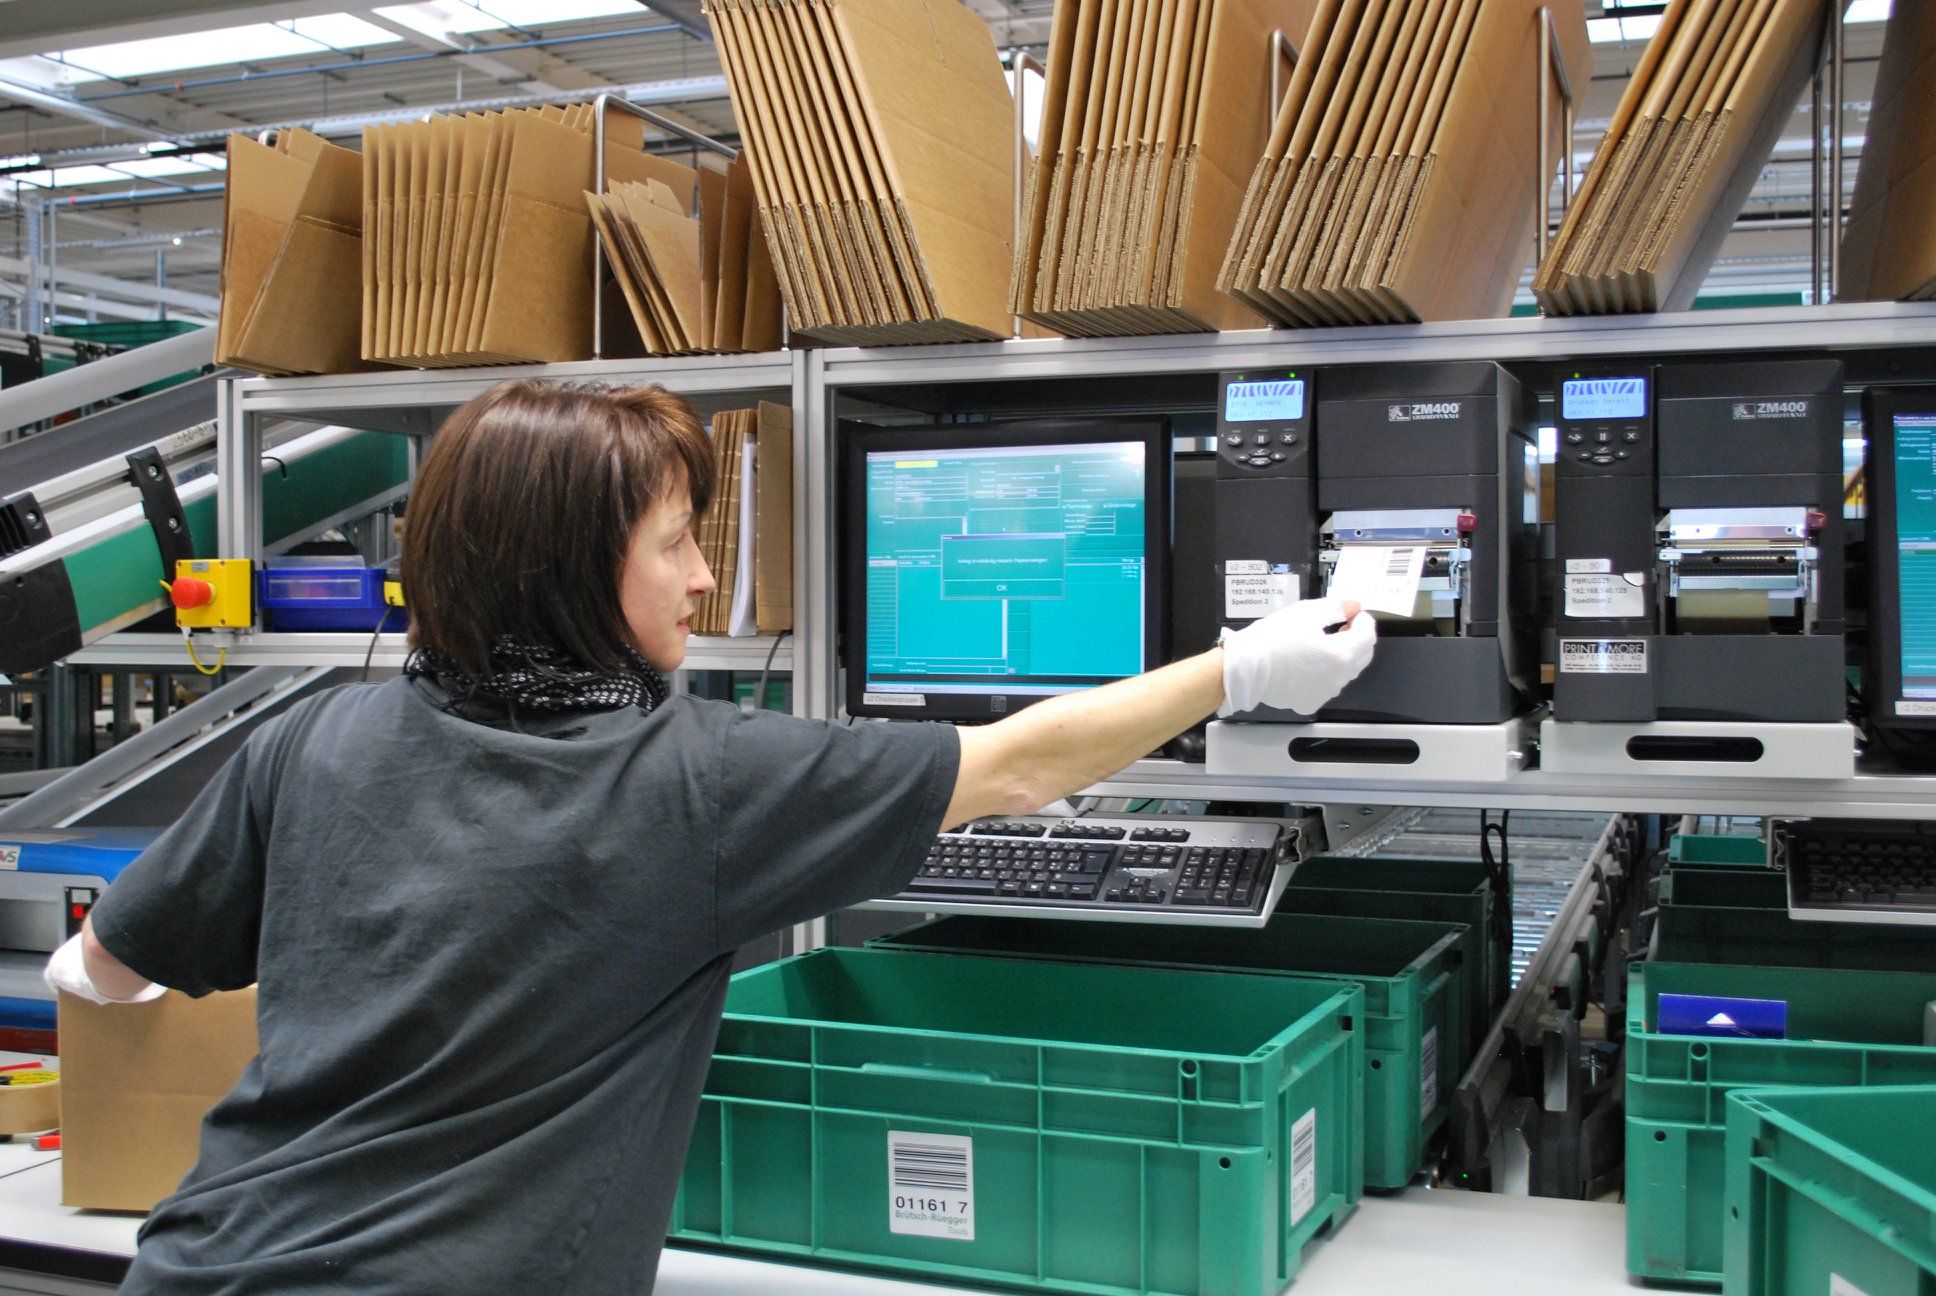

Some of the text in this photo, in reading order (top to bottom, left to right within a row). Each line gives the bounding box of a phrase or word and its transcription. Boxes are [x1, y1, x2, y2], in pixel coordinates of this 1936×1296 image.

[1412, 403, 1459, 415] ZM400
[1757, 401, 1806, 414] ZM400
[996, 584, 1008, 592] OK
[1564, 643, 1597, 654] PRINT
[1606, 643, 1643, 654] MORE
[895, 1196, 968, 1214] 01161 7
